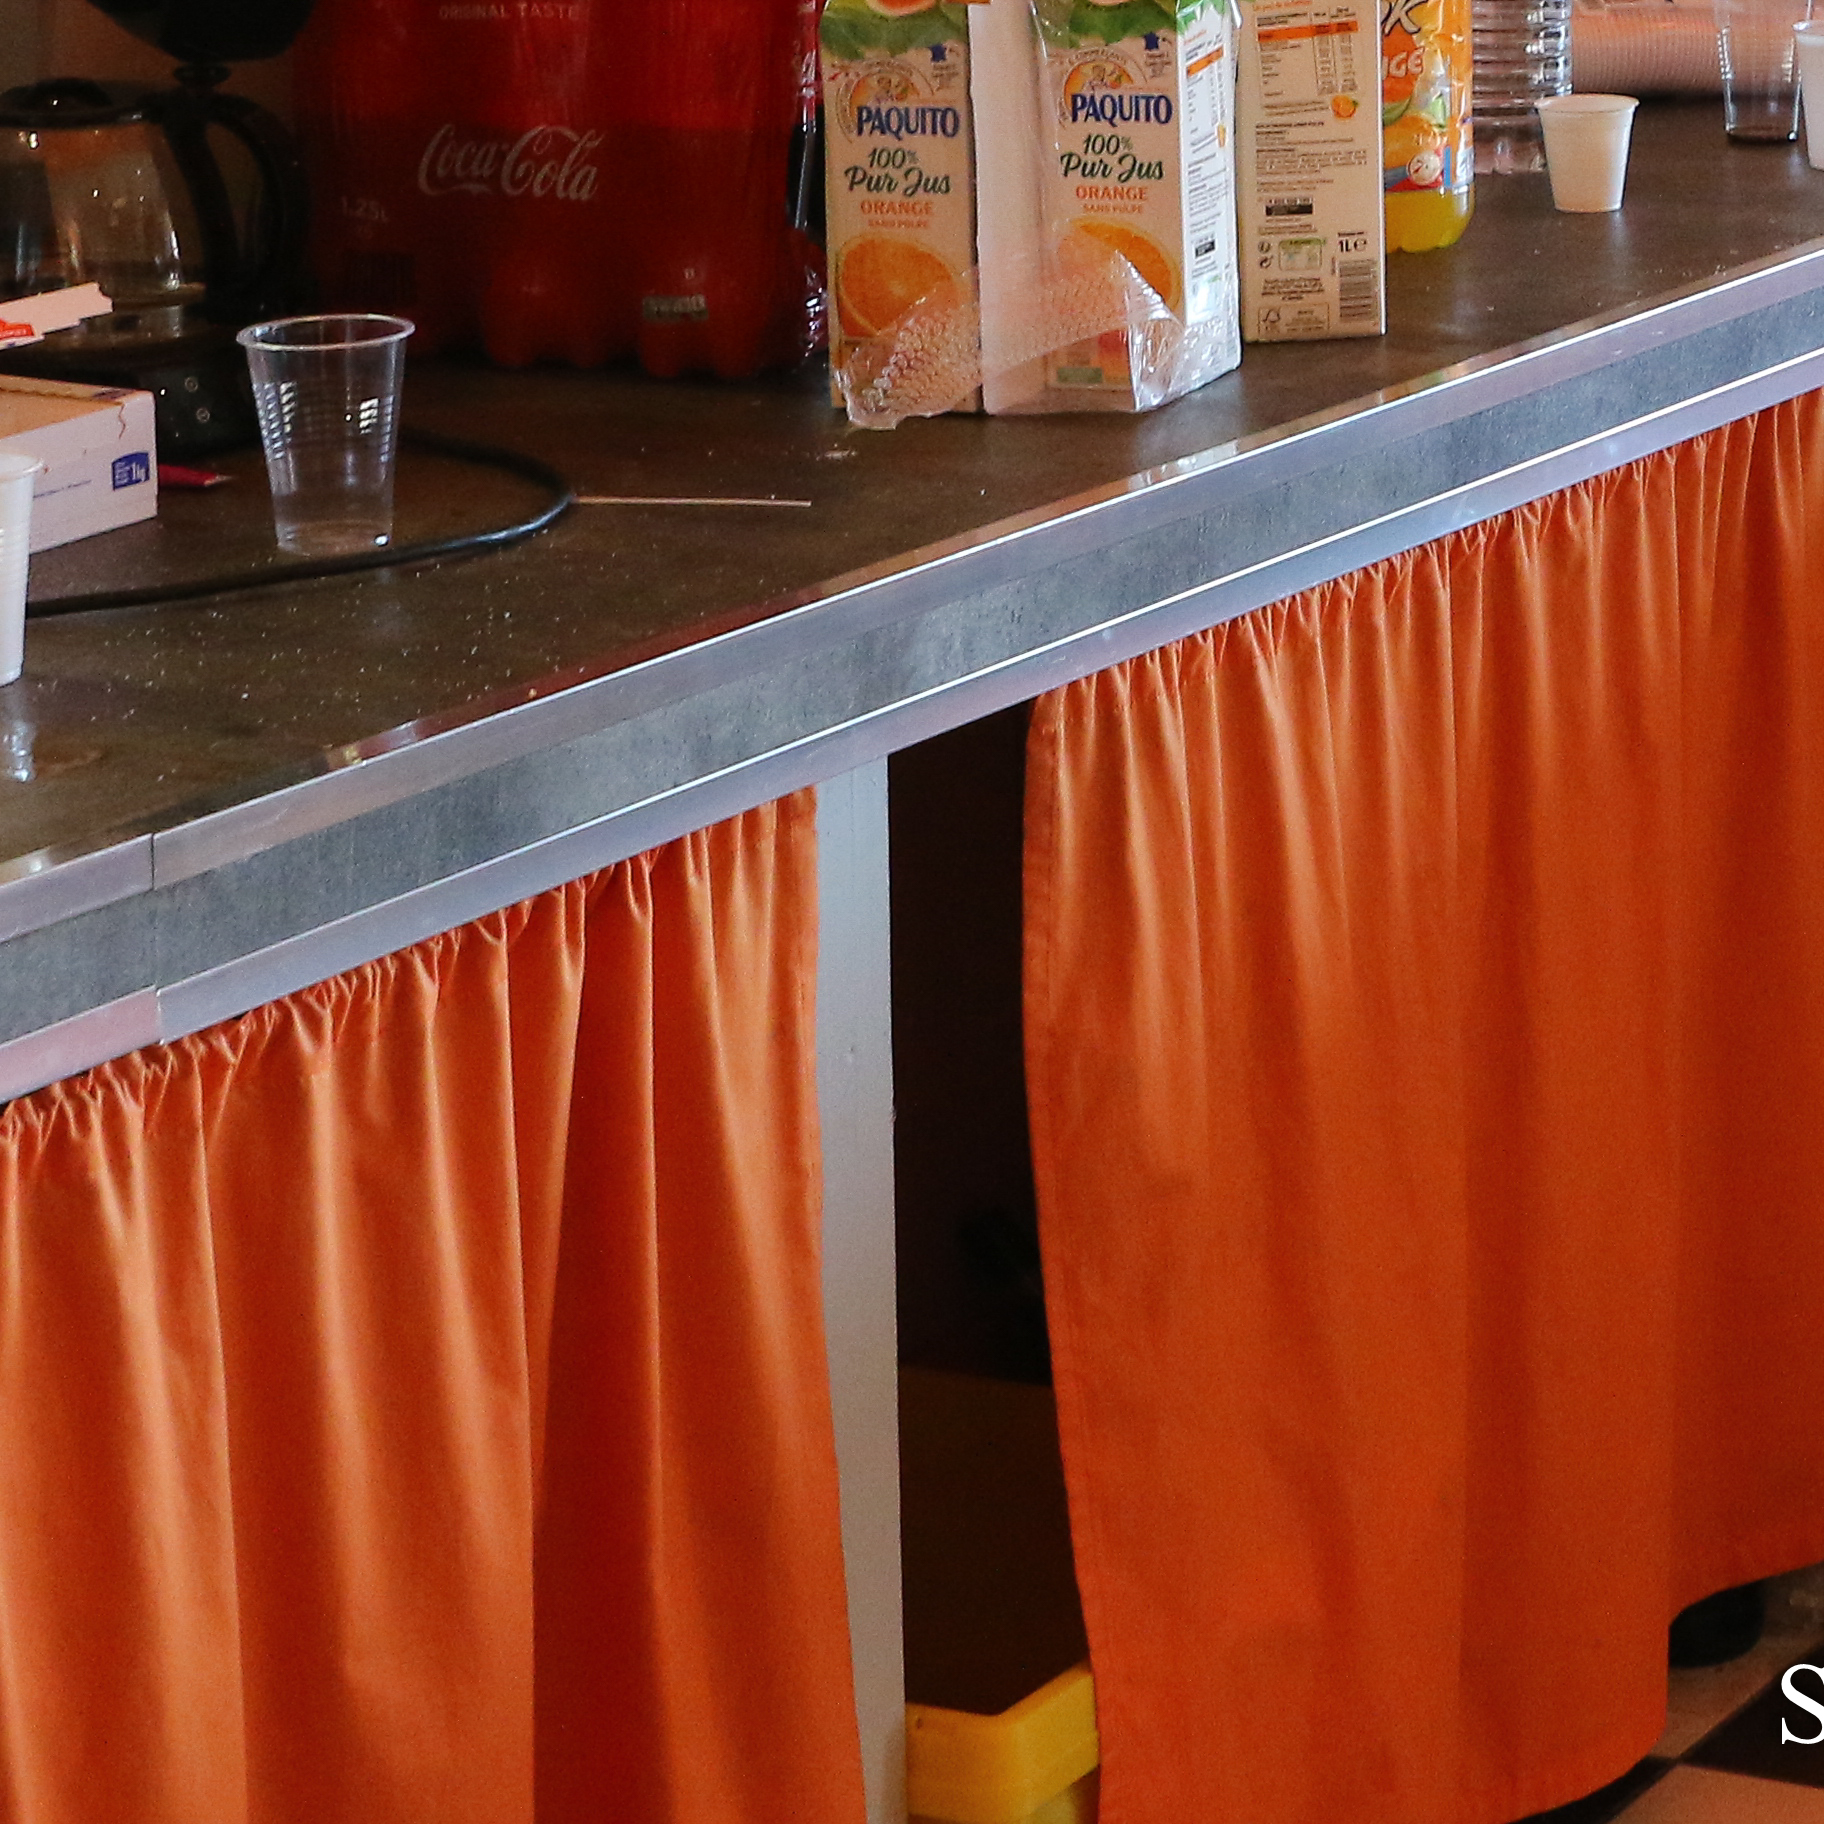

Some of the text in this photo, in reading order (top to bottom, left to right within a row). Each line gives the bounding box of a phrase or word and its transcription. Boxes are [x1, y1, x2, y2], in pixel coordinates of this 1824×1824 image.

[857, 105, 961, 142] PAQUITO
[1071, 93, 1173, 128] PAQUITO
[1083, 133, 1134, 156] 100%
[417, 124, 606, 201] Coca-Cola
[1060, 151, 1164, 184] Pur Jus
[844, 165, 951, 198] Pur Jus
[1076, 185, 1148, 201] ORANGE
[860, 200, 934, 216] ORANGE
